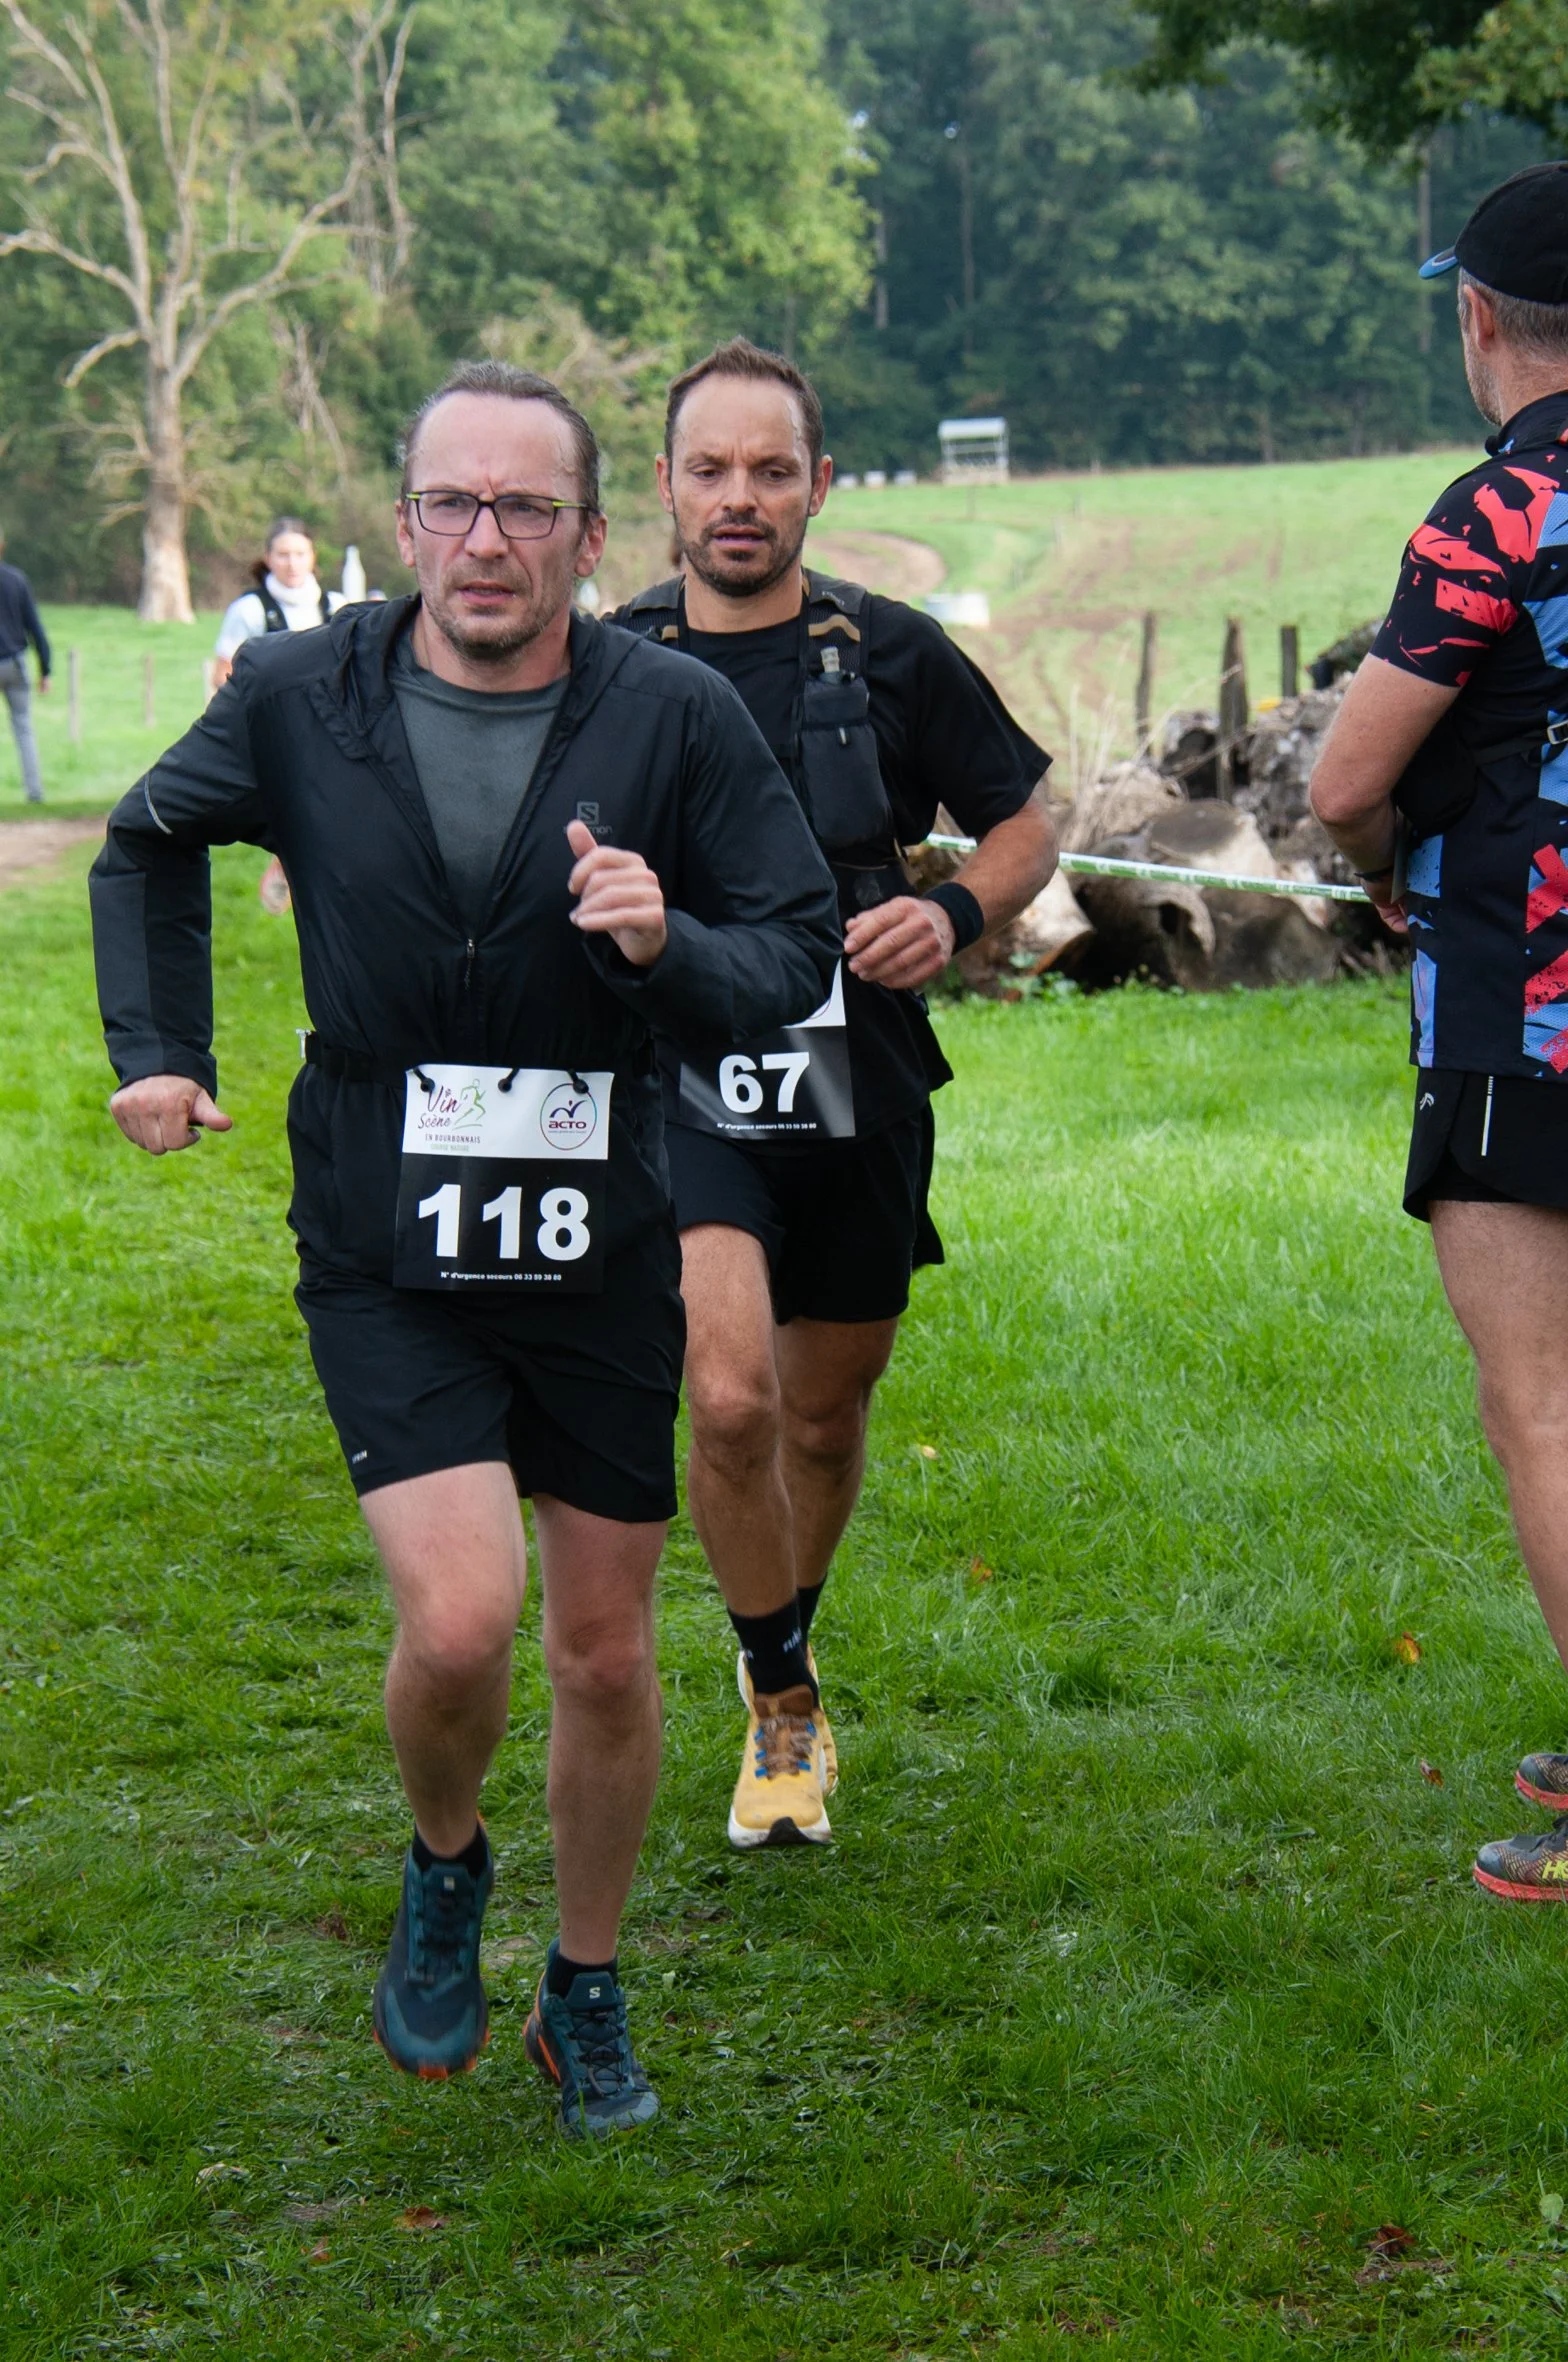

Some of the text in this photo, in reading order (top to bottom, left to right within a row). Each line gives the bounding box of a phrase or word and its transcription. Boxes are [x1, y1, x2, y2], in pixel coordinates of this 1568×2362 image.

[719, 1051, 810, 1113] 67
[435, 1134, 482, 1144] BOURBONNAIS
[418, 1183, 591, 1262] 118
[450, 1272, 486, 1281] d'urgence
